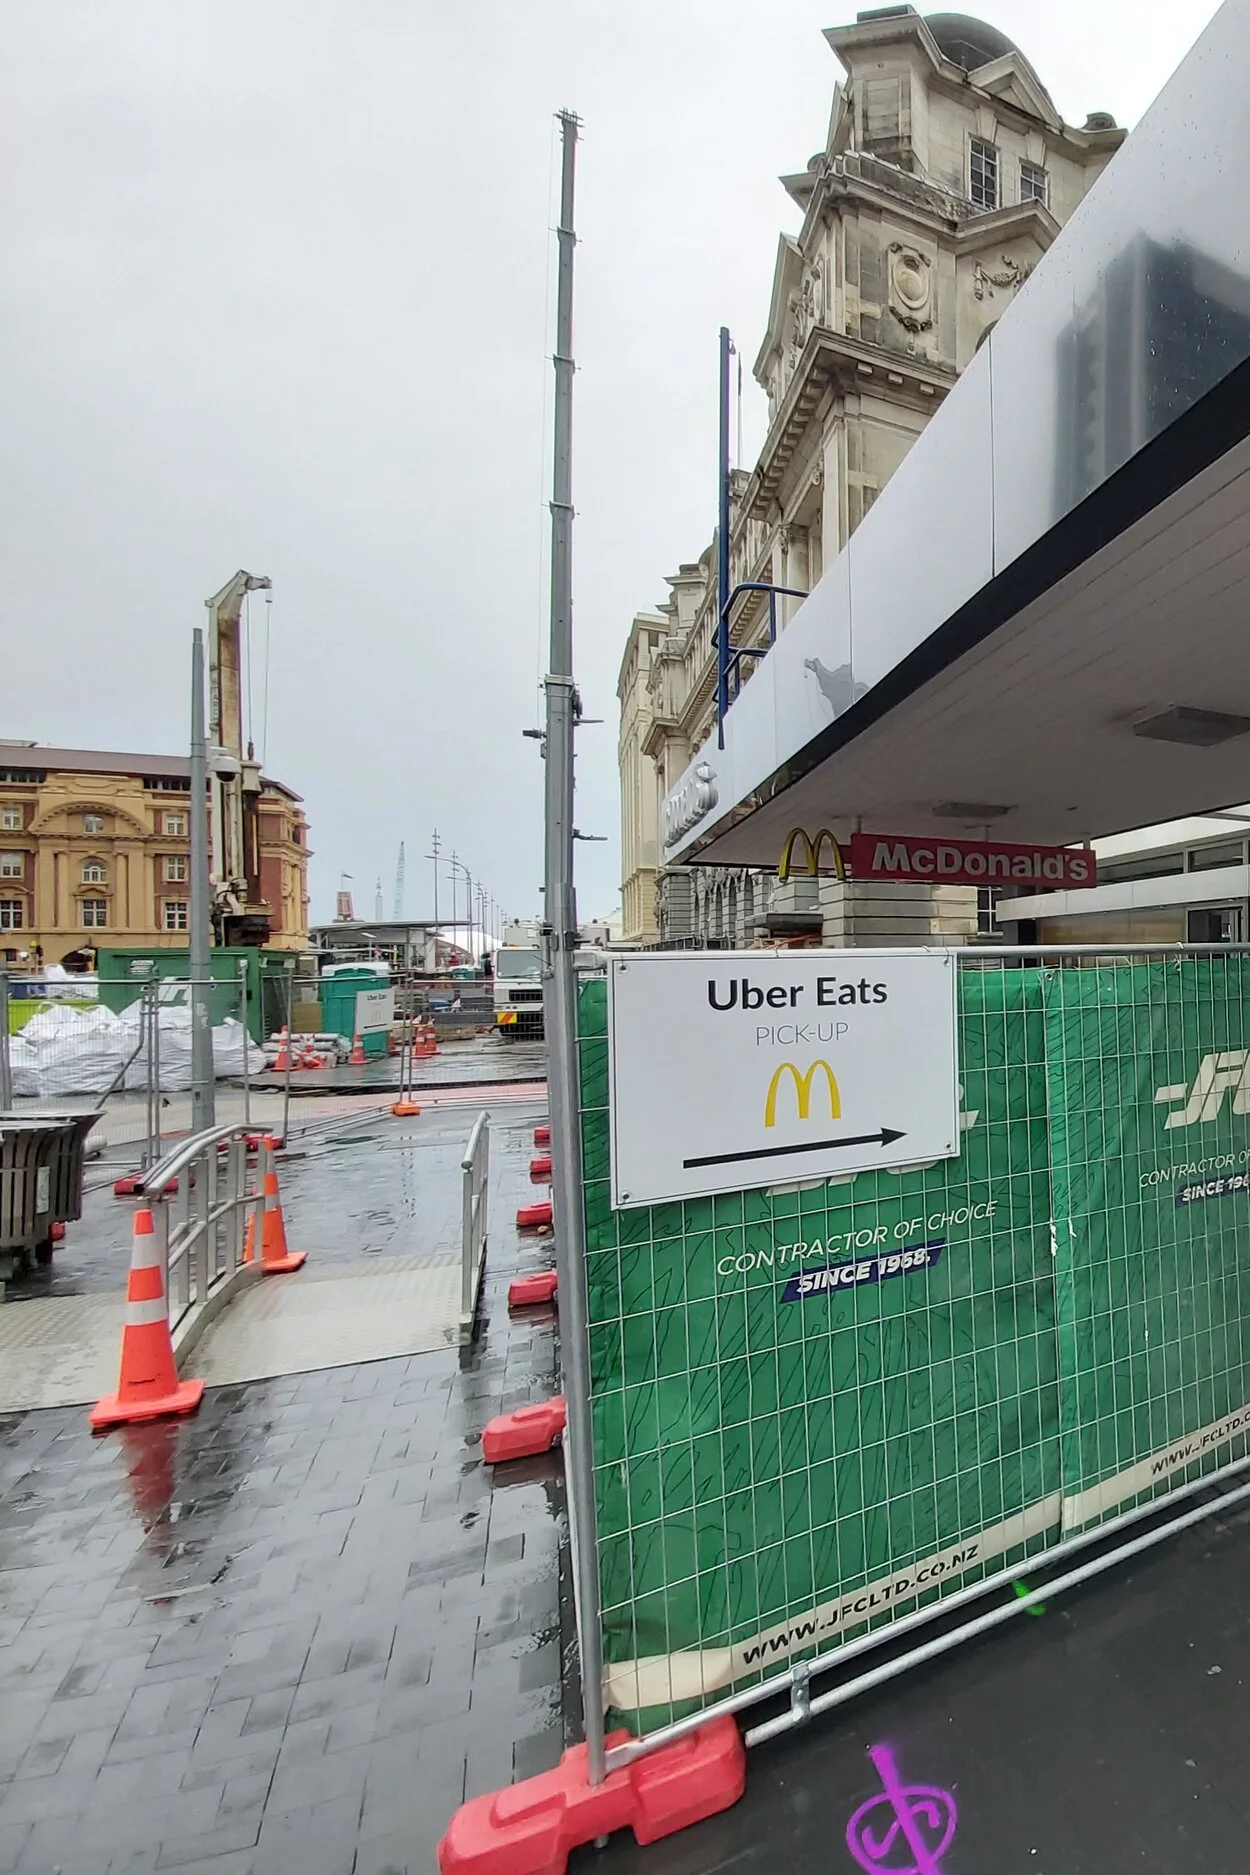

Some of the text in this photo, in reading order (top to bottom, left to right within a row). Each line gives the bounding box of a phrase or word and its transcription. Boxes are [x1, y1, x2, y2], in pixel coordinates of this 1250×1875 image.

[871, 842, 1089, 882] McDonald's
[707, 976, 888, 1012] Uber Eats
[755, 1021, 849, 1046] PICK-UP
[1138, 1153, 1237, 1189] CONTRACTOR
[1181, 1178, 1224, 1203] SINCE
[716, 1201, 1000, 1278] CONTRACTOR OF CHOICE
[796, 1260, 871, 1294] SINCE
[742, 1544, 979, 1665] WWW.JFCLTD.CO.NZ
